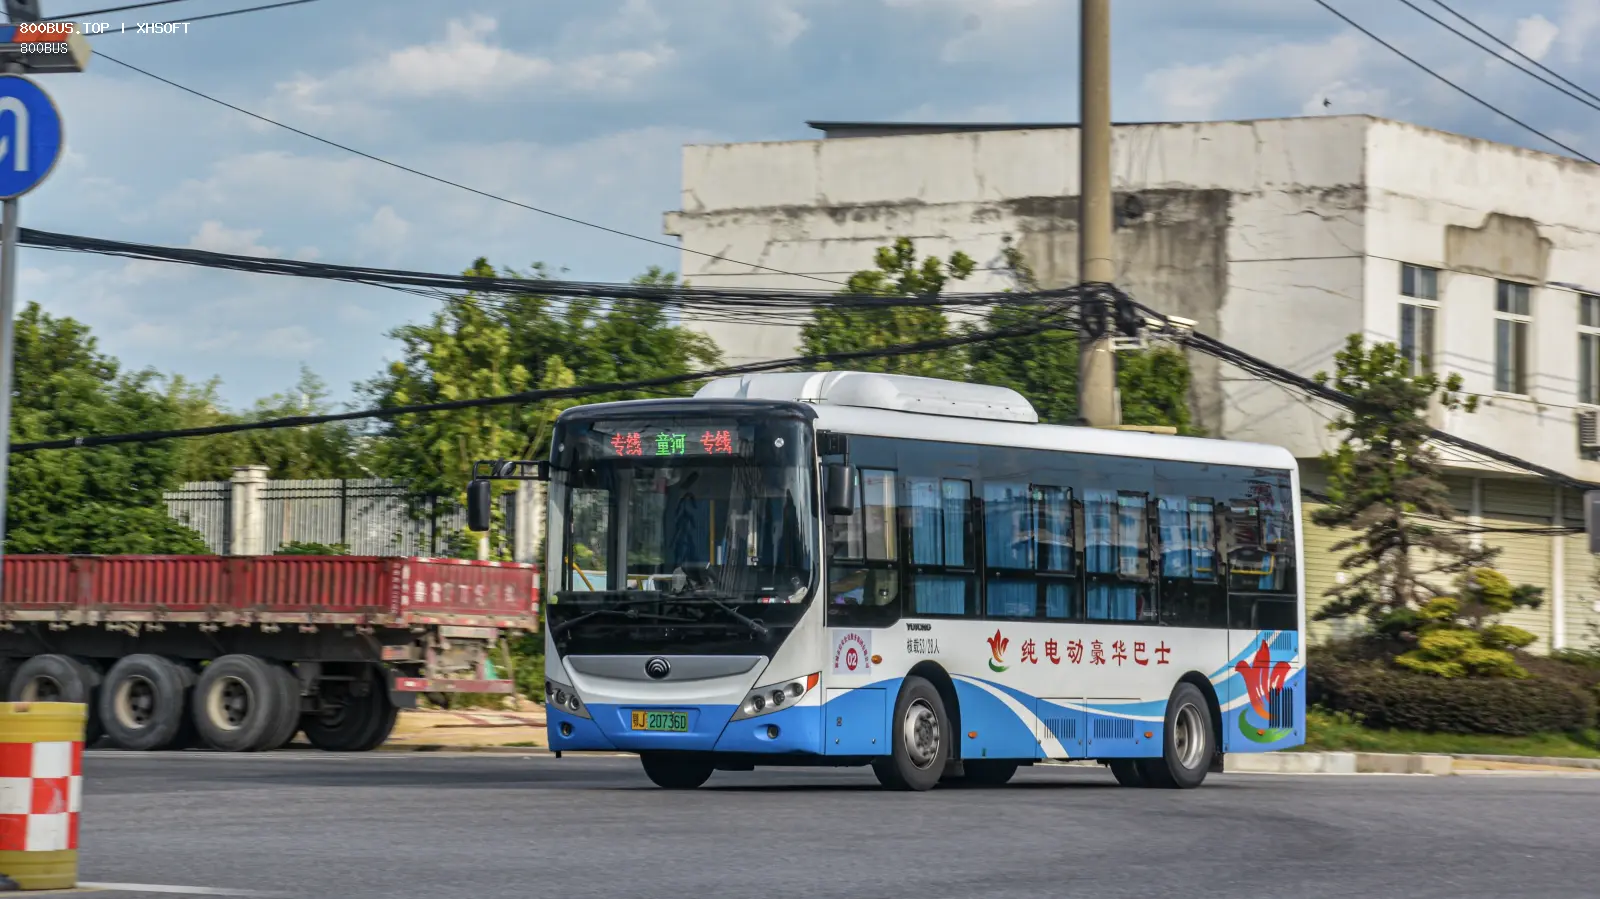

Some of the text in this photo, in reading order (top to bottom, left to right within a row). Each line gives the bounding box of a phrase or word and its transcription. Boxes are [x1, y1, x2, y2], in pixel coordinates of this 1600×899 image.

[610, 430, 733, 456] 专线 童河 专线
[847, 652, 858, 667] 02
[1020, 637, 1171, 667] 纯电动豪华巴士
